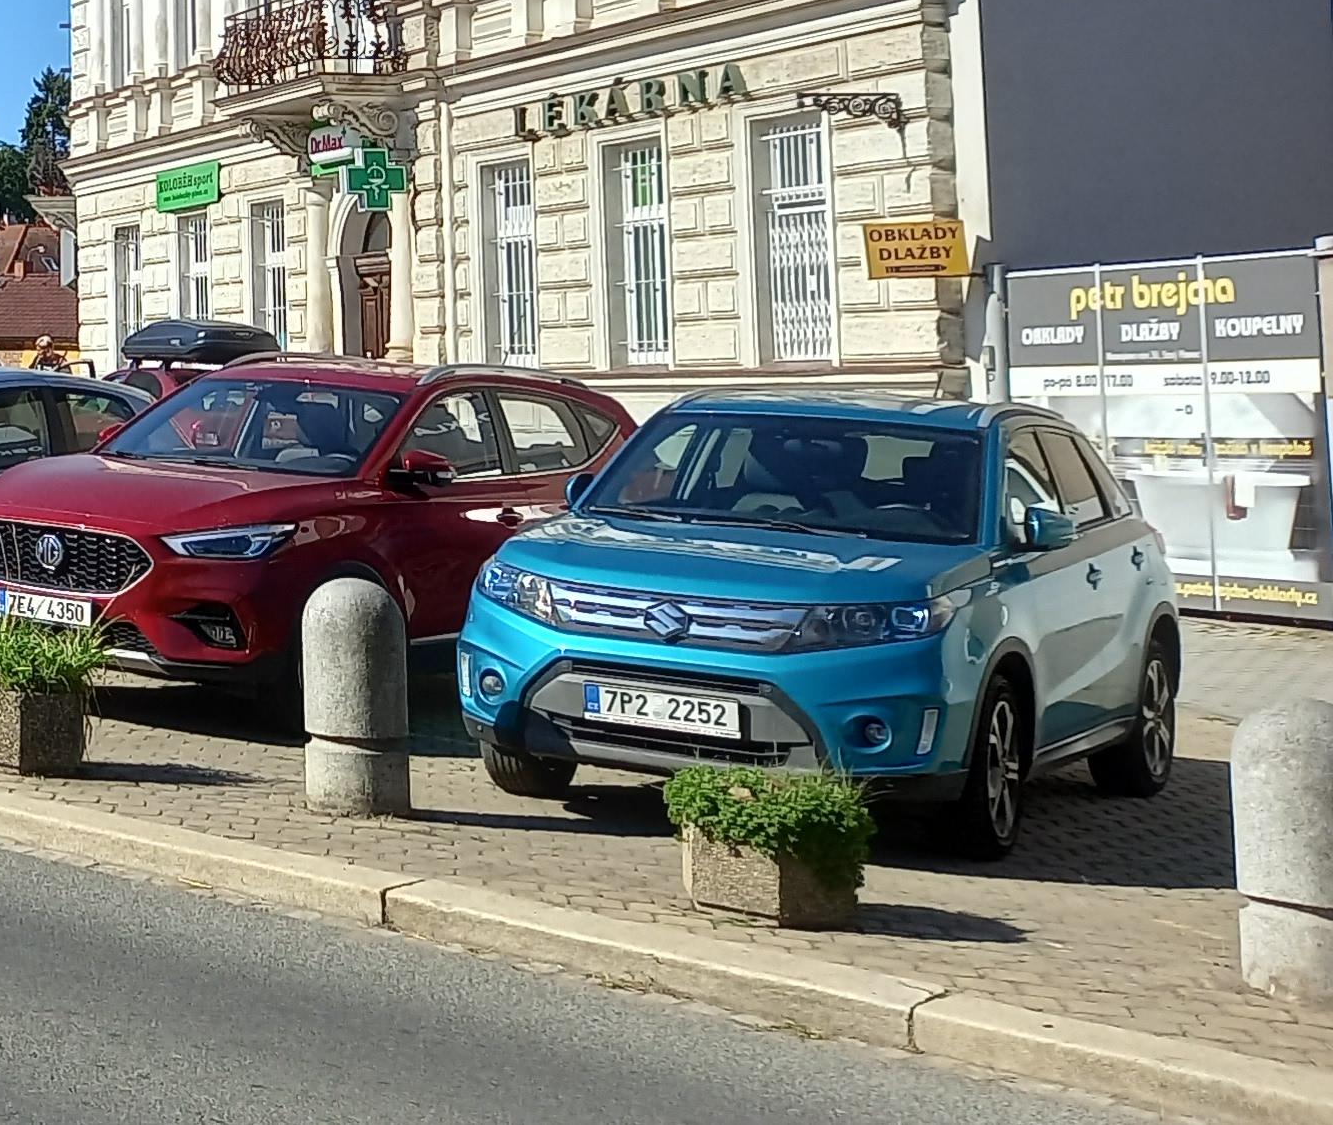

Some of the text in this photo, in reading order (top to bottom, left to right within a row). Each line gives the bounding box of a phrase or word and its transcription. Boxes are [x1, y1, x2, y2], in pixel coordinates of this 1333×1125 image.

[513, 61, 748, 137] LÉKÁRNA
[869, 226, 959, 243] OBKLADY
[878, 244, 953, 261] DLAŽBY
[1069, 281, 1126, 320] petr
[1021, 314, 1304, 345] OBKLADY DLAŽBY KOUPELNY
[1211, 371, 1271, 385] 9.00-12.00
[8, 594, 85, 623] 7E4 4350
[604, 690, 649, 717] 7P2
[667, 697, 729, 727] 2252
